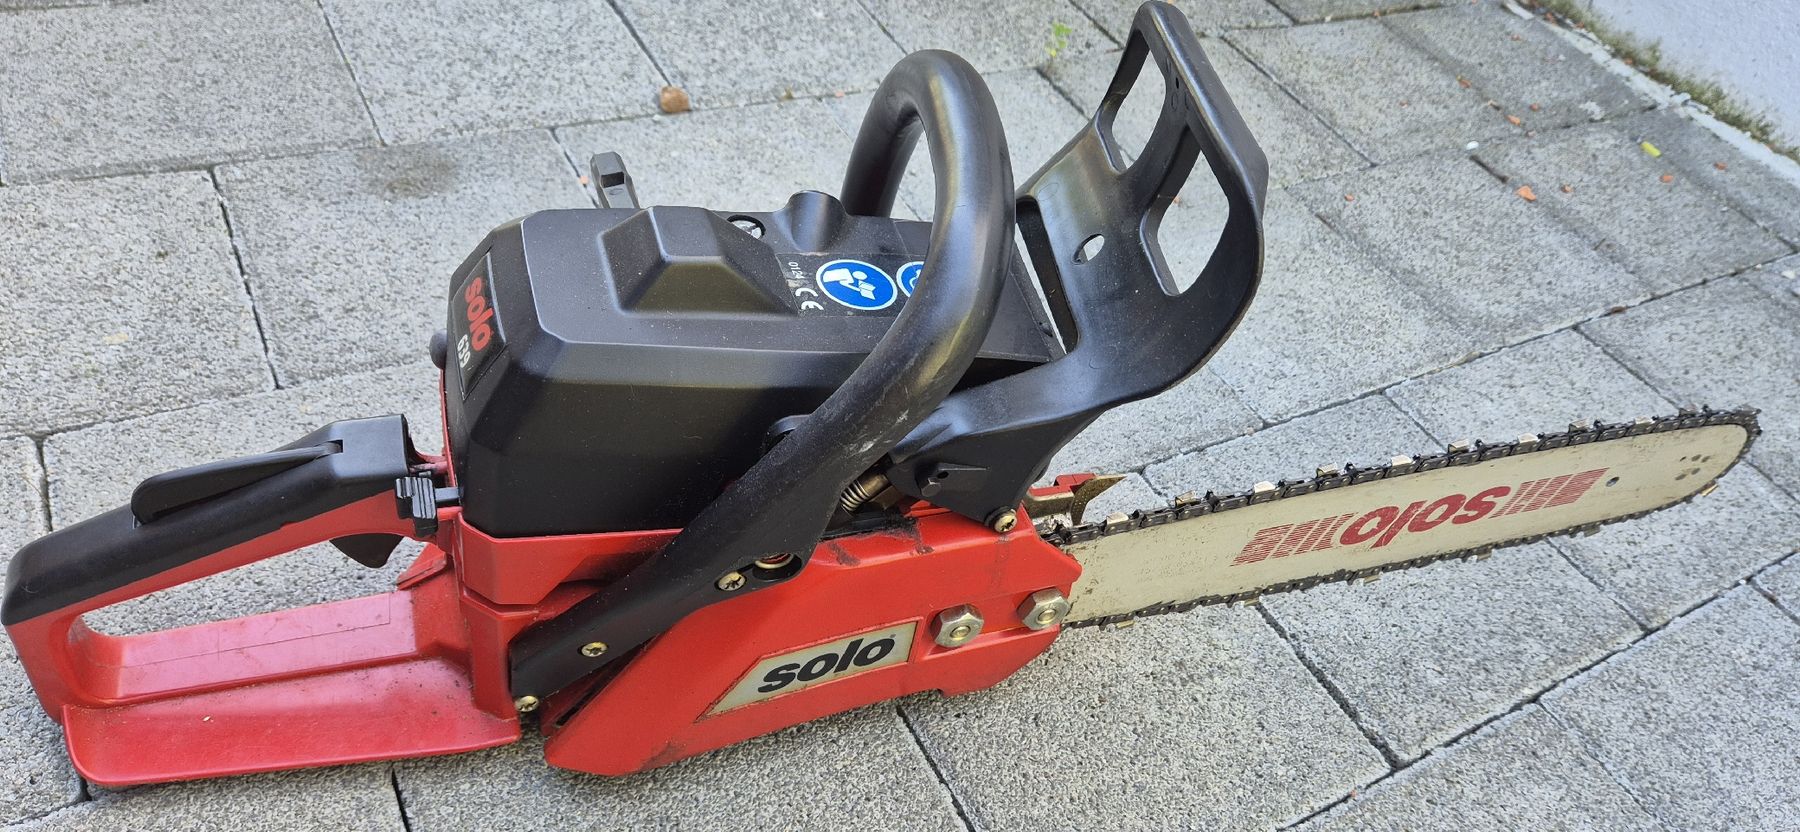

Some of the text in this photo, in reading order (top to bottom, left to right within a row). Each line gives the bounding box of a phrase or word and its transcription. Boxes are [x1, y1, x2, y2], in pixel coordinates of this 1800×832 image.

[465, 276, 493, 351] solo
[795, 287, 824, 310] CE
[457, 334, 471, 368] 639
[1340, 486, 1511, 549] solo
[757, 637, 896, 693] solo
